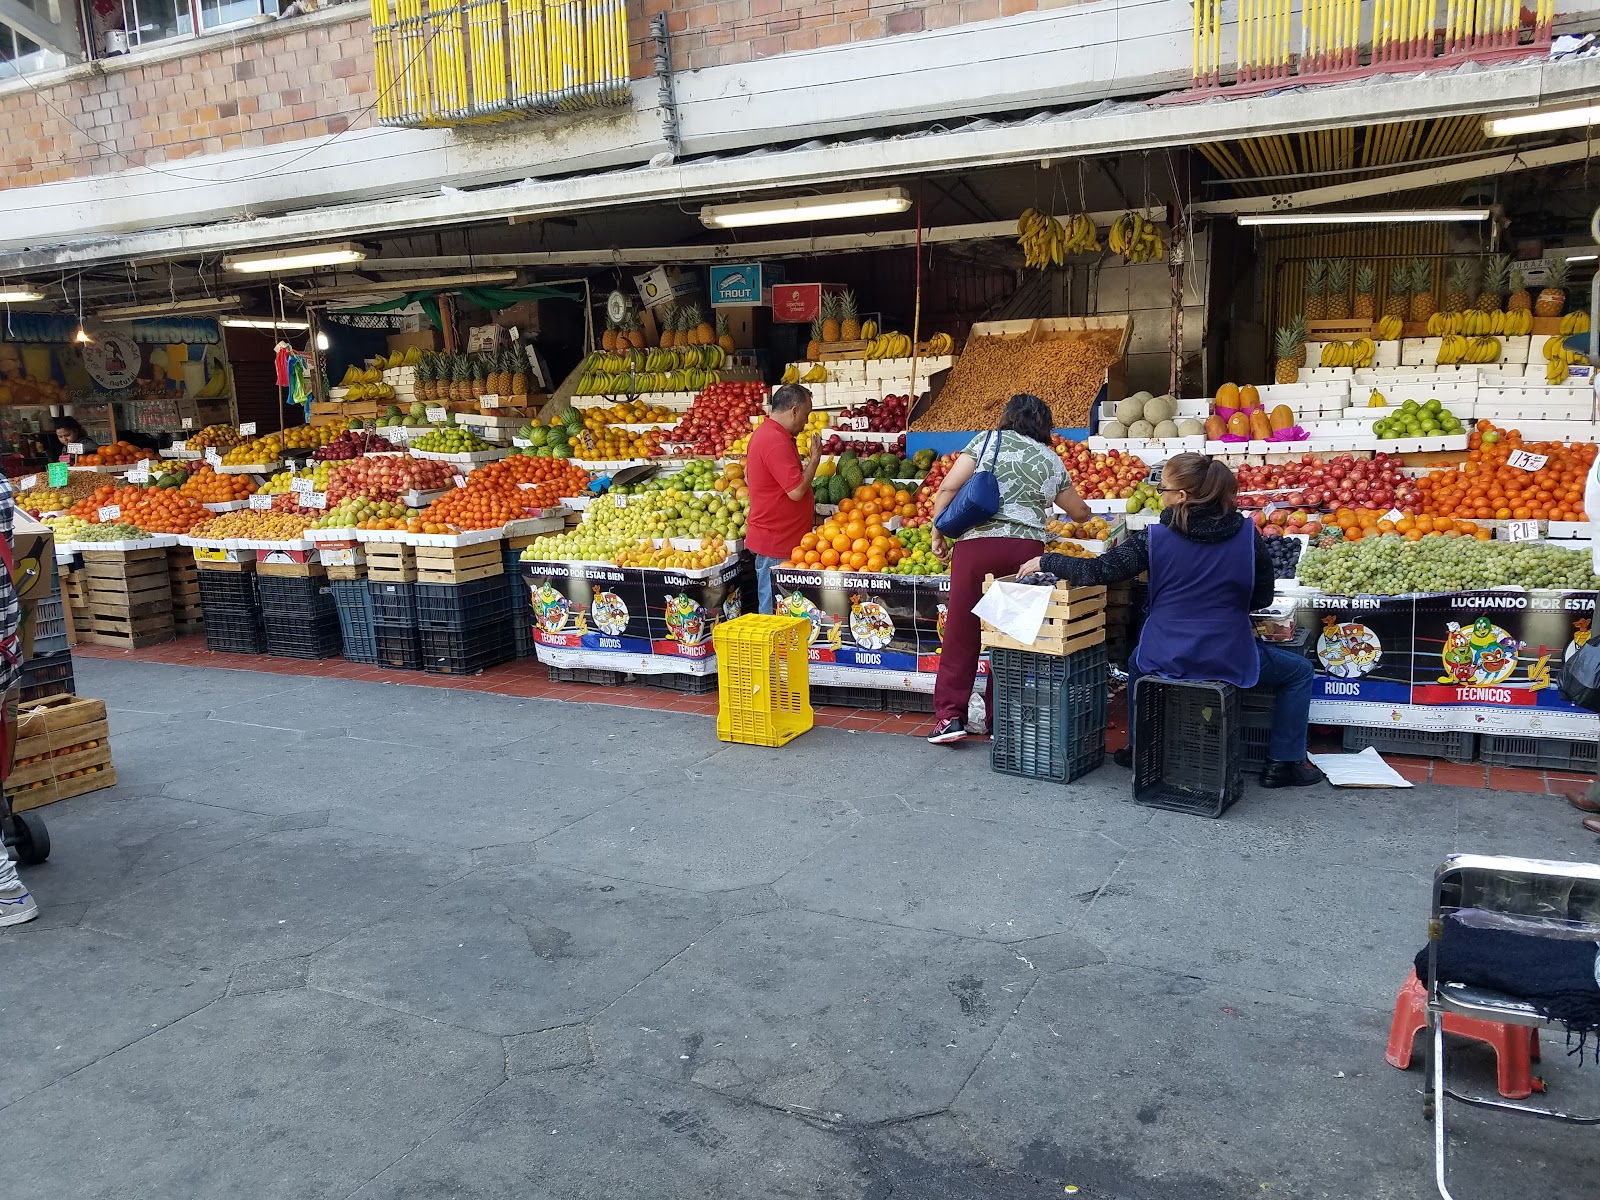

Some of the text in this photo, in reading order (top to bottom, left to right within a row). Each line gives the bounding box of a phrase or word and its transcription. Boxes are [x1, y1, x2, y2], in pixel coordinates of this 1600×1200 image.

[719, 289, 751, 299] TROUT
[530, 566, 625, 582] LUCHANDO POR ESTAR BIEN
[664, 575, 707, 587] LUCHANDO
[708, 576, 722, 588] POR
[776, 574, 891, 589] LUCHANDO POR ESTAR BIEN
[1313, 599, 1349, 609] ESTAR
[1351, 599, 1380, 609] BIEN
[1451, 597, 1596, 610] LUCHANDO POR ESTA
[600, 637, 622, 648] RUDOS
[855, 652, 881, 665] RUDOS
[1528, 654, 1552, 692] VS
[1325, 681, 1360, 695] RUDOS
[1456, 685, 1511, 702] TÉCNICOS
